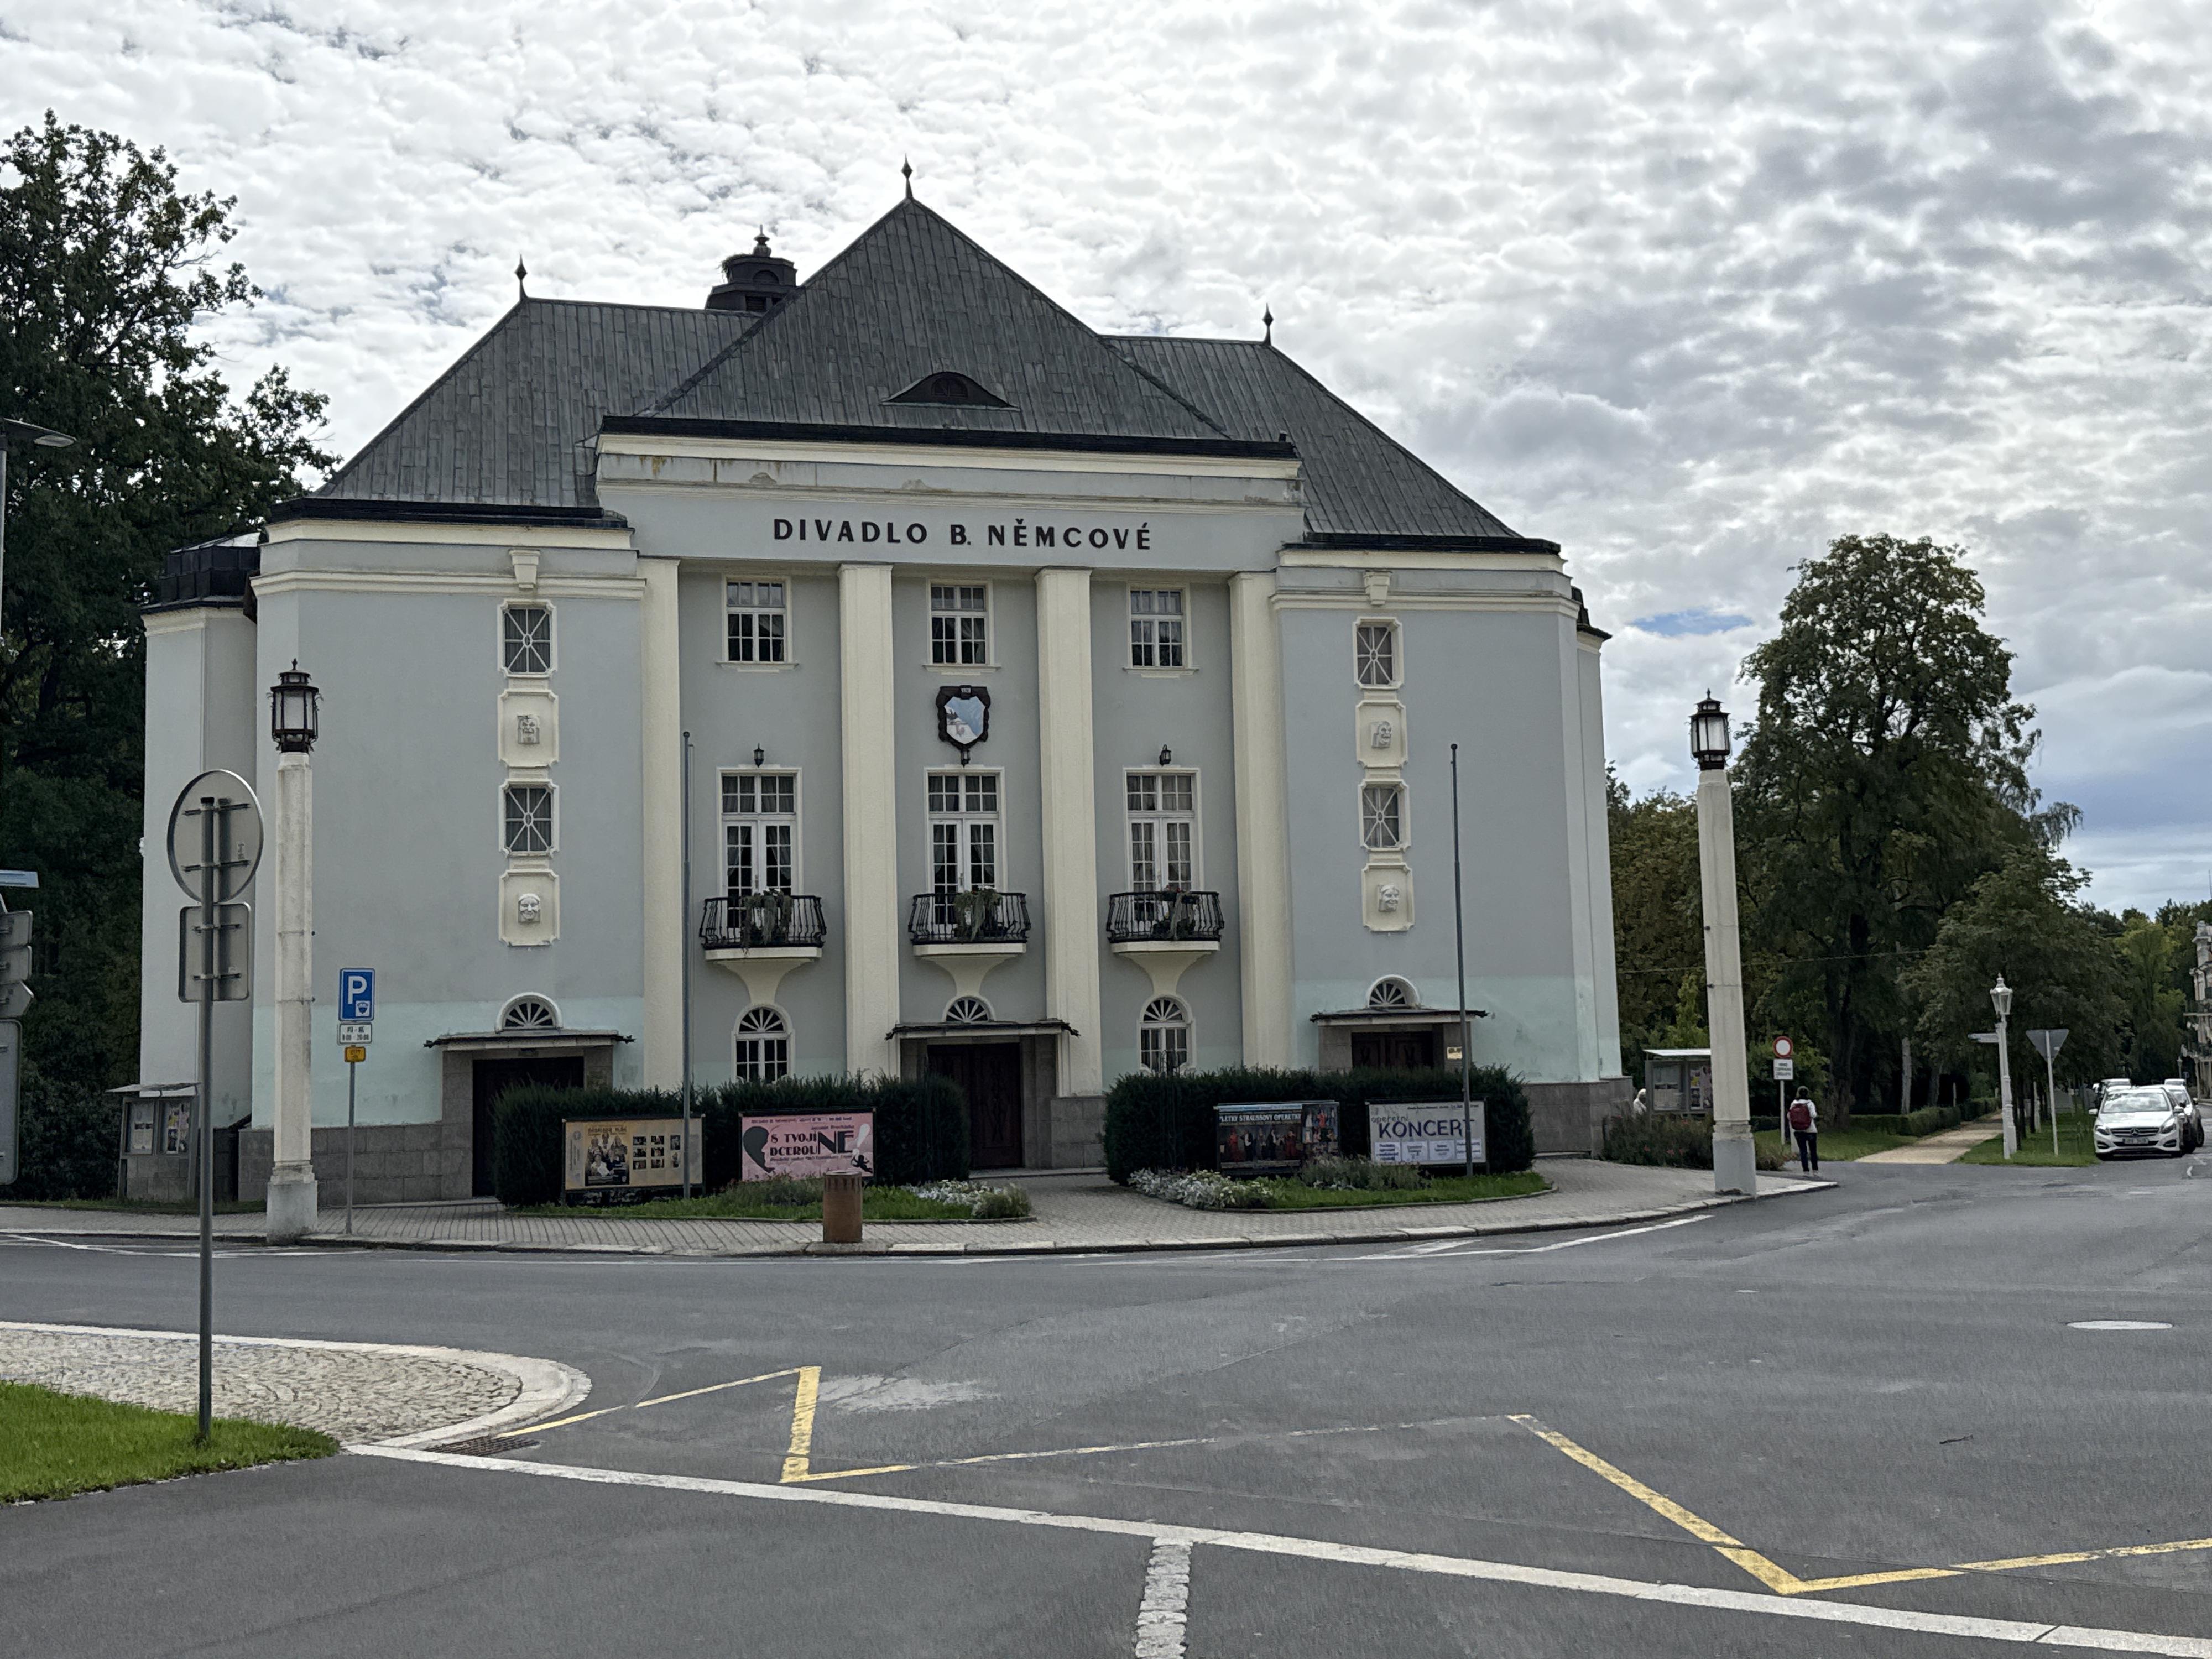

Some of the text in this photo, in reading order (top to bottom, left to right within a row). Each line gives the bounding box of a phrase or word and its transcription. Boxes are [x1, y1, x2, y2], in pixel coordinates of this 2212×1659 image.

[773, 518, 1151, 550] DIVADLO B. NĚMCOVÉ
[347, 975, 367, 1005] P
[770, 1134, 779, 1144] S
[770, 1145, 817, 1156] DCEROU
